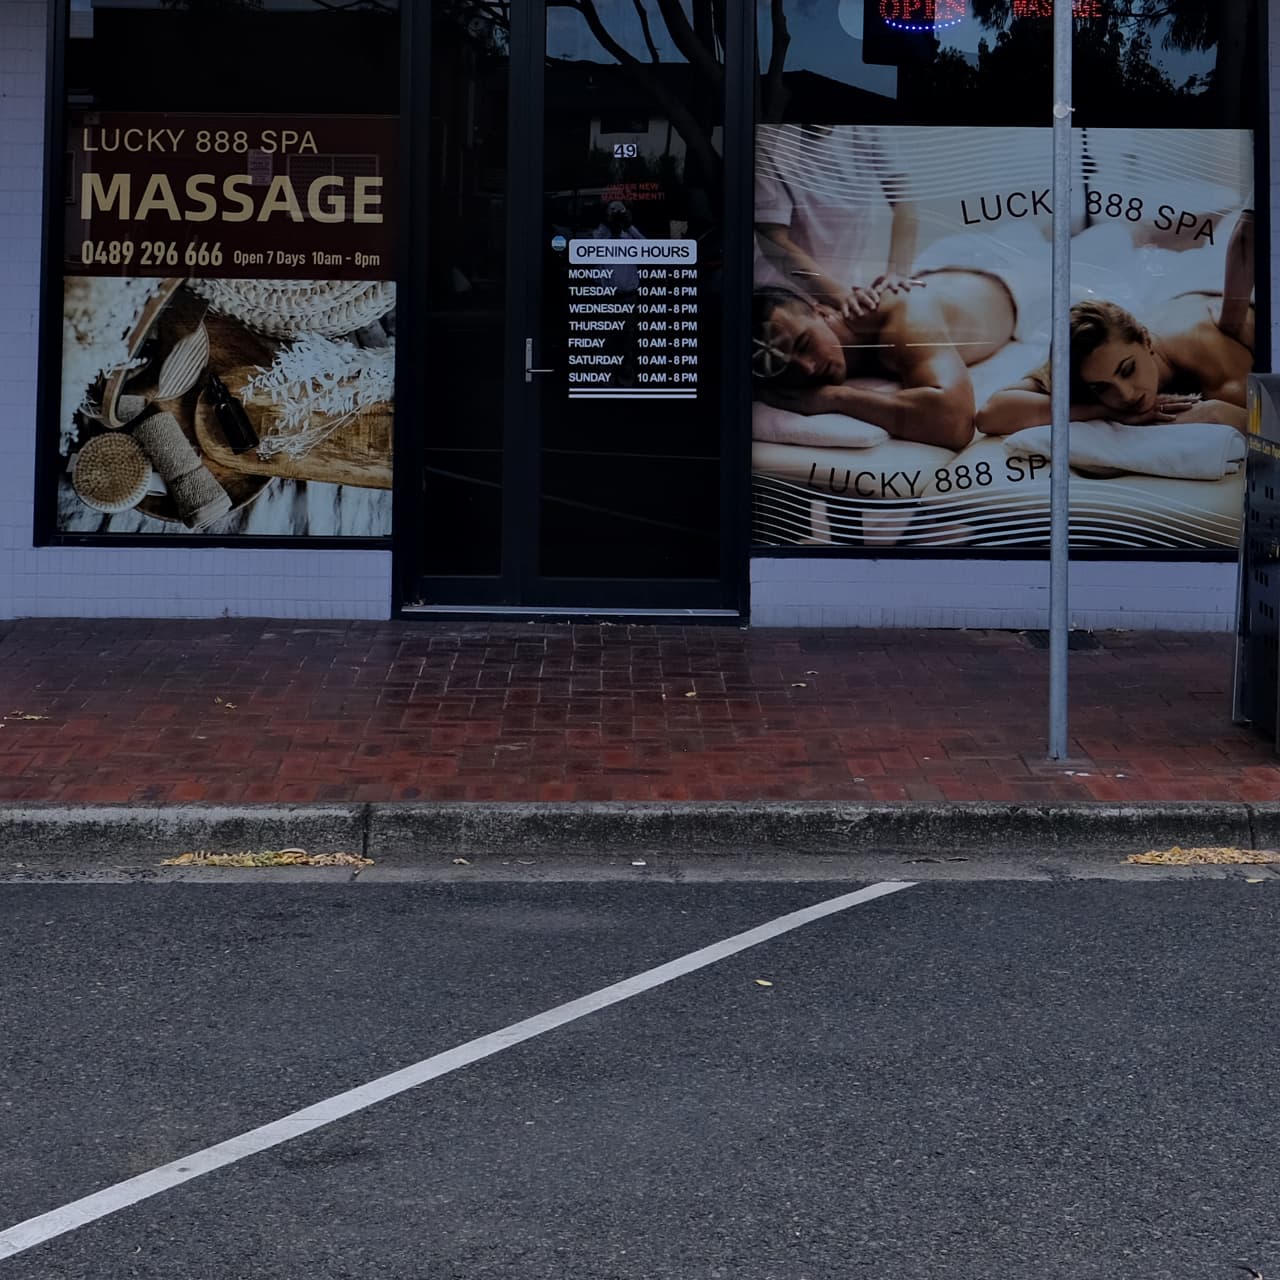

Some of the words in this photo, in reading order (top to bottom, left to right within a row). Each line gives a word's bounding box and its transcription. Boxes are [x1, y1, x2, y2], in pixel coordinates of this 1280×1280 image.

[83, 128, 185, 152] LUCKY
[196, 130, 248, 153] 888
[260, 130, 319, 154] SPA
[615, 144, 635, 157] 49
[80, 173, 384, 224] MASSAGE
[961, 189, 1053, 226] LUCK
[1087, 191, 1143, 223] 888
[1153, 205, 1216, 246] SPA
[81, 240, 134, 265] 0489
[140, 241, 178, 266] 296
[184, 242, 223, 266] 666
[233, 250, 263, 268] Open
[266, 251, 273, 264] 7
[276, 251, 306, 269] Days
[312, 252, 342, 265] 10am
[354, 252, 381, 269] 8pm
[576, 246, 638, 258] OPENING
[641, 246, 690, 258] HOURS
[569, 269, 613, 279] MONDAY
[637, 269, 648, 279] 10
[650, 269, 666, 279] AM
[674, 269, 679, 279] 8
[681, 269, 697, 279] PM
[569, 287, 617, 296] TUESDAY
[569, 304, 635, 313] WEDNESDAY
[569, 321, 625, 331] THURSDAY
[569, 338, 605, 348] FRIDAY
[569, 356, 624, 365] SATURDAY
[569, 373, 611, 382] SUNDAY
[807, 462, 921, 498] LUCKY
[934, 462, 993, 494] 888
